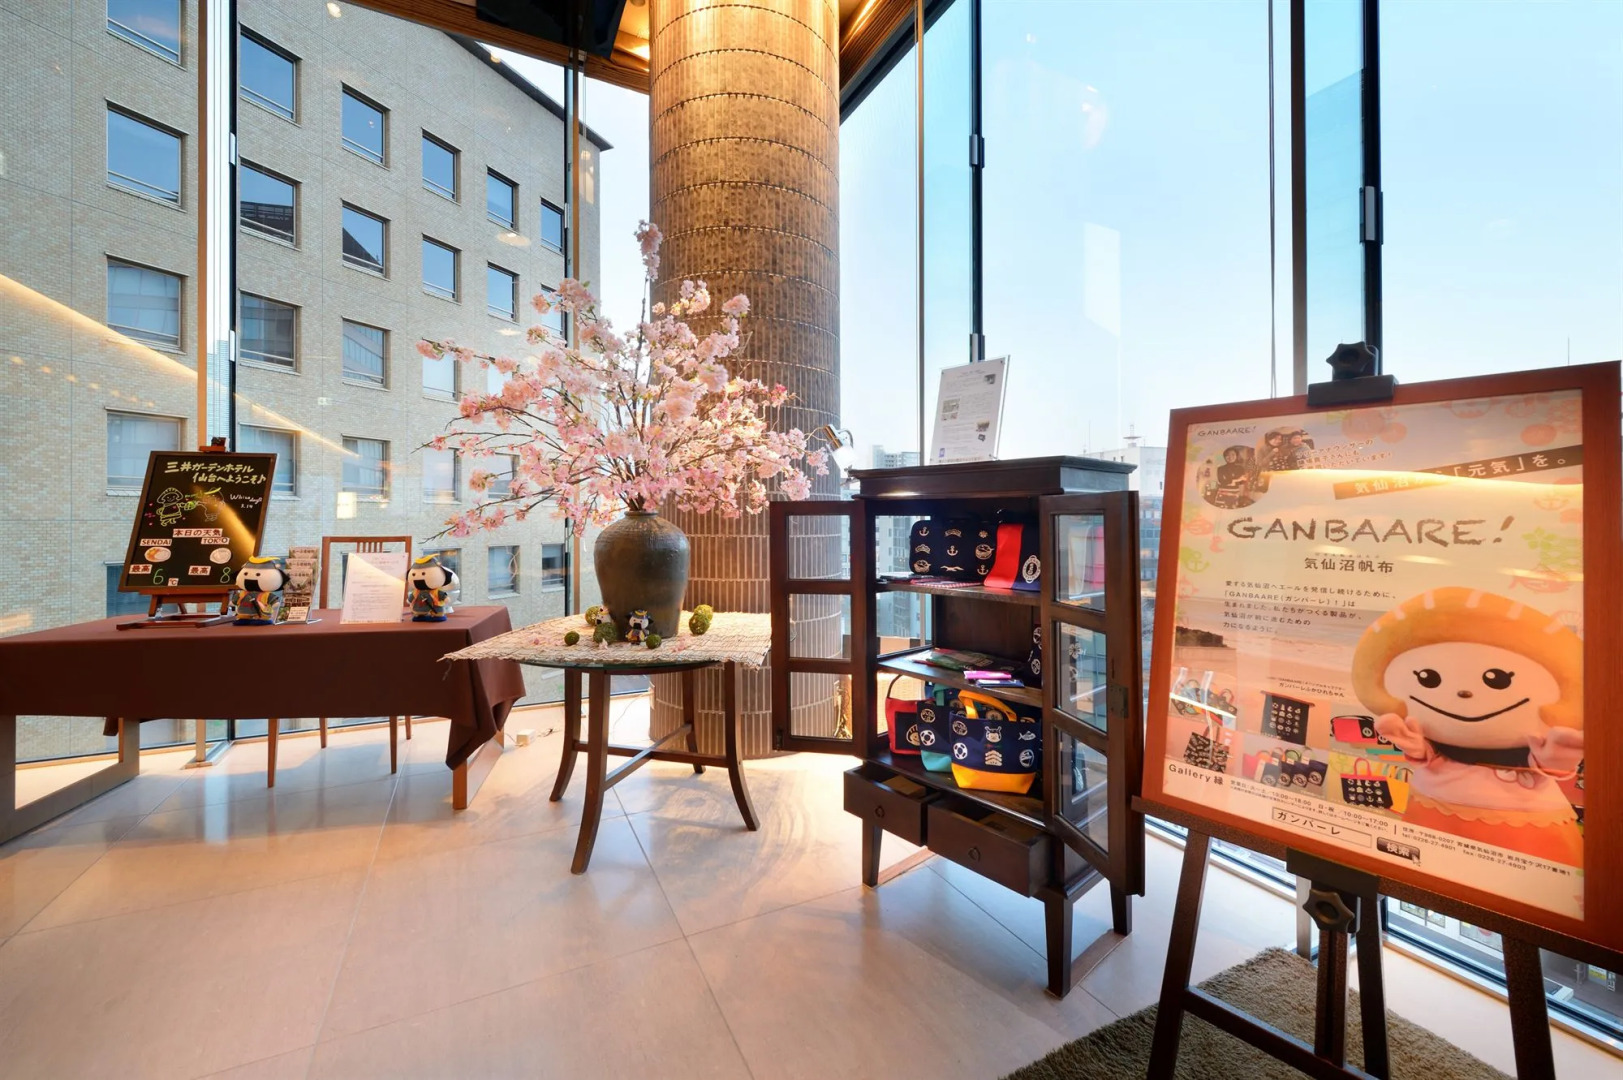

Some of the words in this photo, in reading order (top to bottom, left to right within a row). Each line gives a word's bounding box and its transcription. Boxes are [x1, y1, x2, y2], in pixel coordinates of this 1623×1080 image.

[1197, 425, 1257, 437] GANBAARE!
[164, 461, 254, 474] 三井ガーデンホテル
[1354, 453, 1567, 495] 気仙沼「元気」を。
[174, 529, 222, 537] 本日の天気
[1226, 516, 1515, 548] GANBAARE!
[131, 564, 151, 573] 最高
[189, 566, 209, 575] 最高
[1303, 556, 1395, 575] 気仙沼帆布
[153, 568, 164, 585] 6
[219, 566, 231, 584] 8
[1168, 763, 1212, 784] Gallery
[1276, 811, 1341, 836] ガンバーレ
[1386, 841, 1411, 857] 検索
